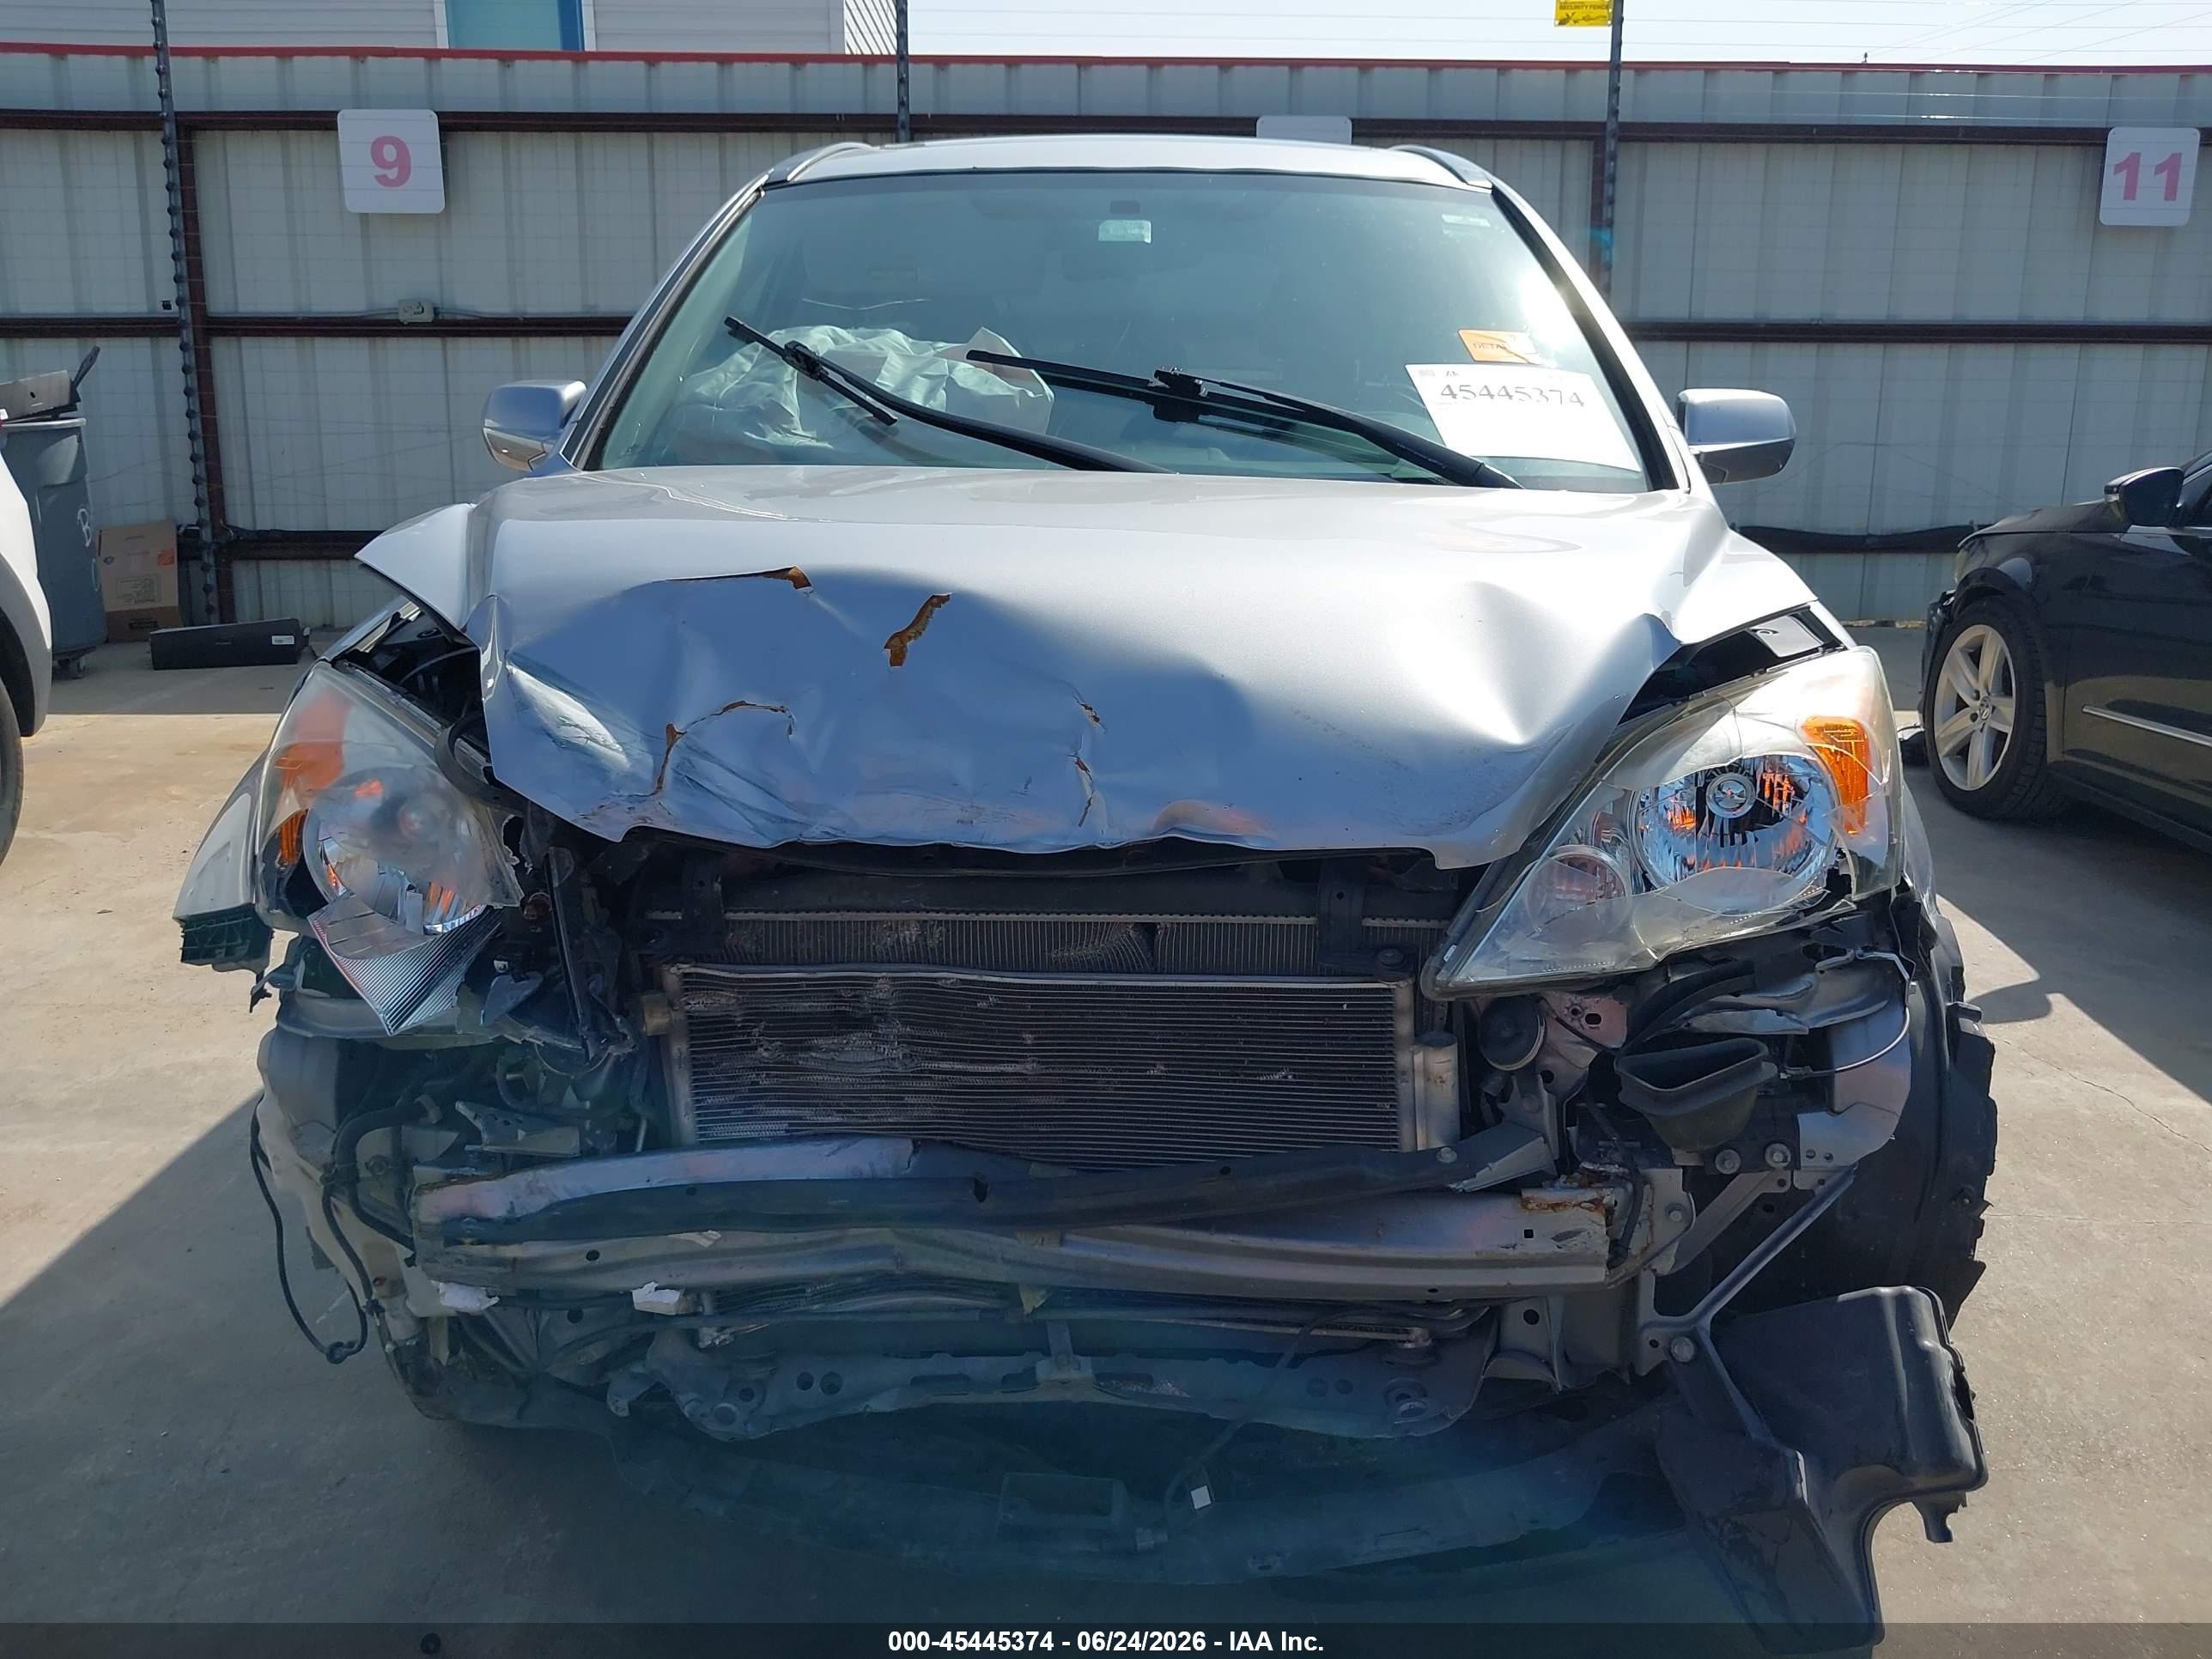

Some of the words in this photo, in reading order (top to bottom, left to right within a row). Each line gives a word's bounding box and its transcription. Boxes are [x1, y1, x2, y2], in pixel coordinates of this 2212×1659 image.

[370, 136, 411, 187] 9
[2112, 152, 2182, 201] 11
[1440, 384, 1585, 407] 45445374
